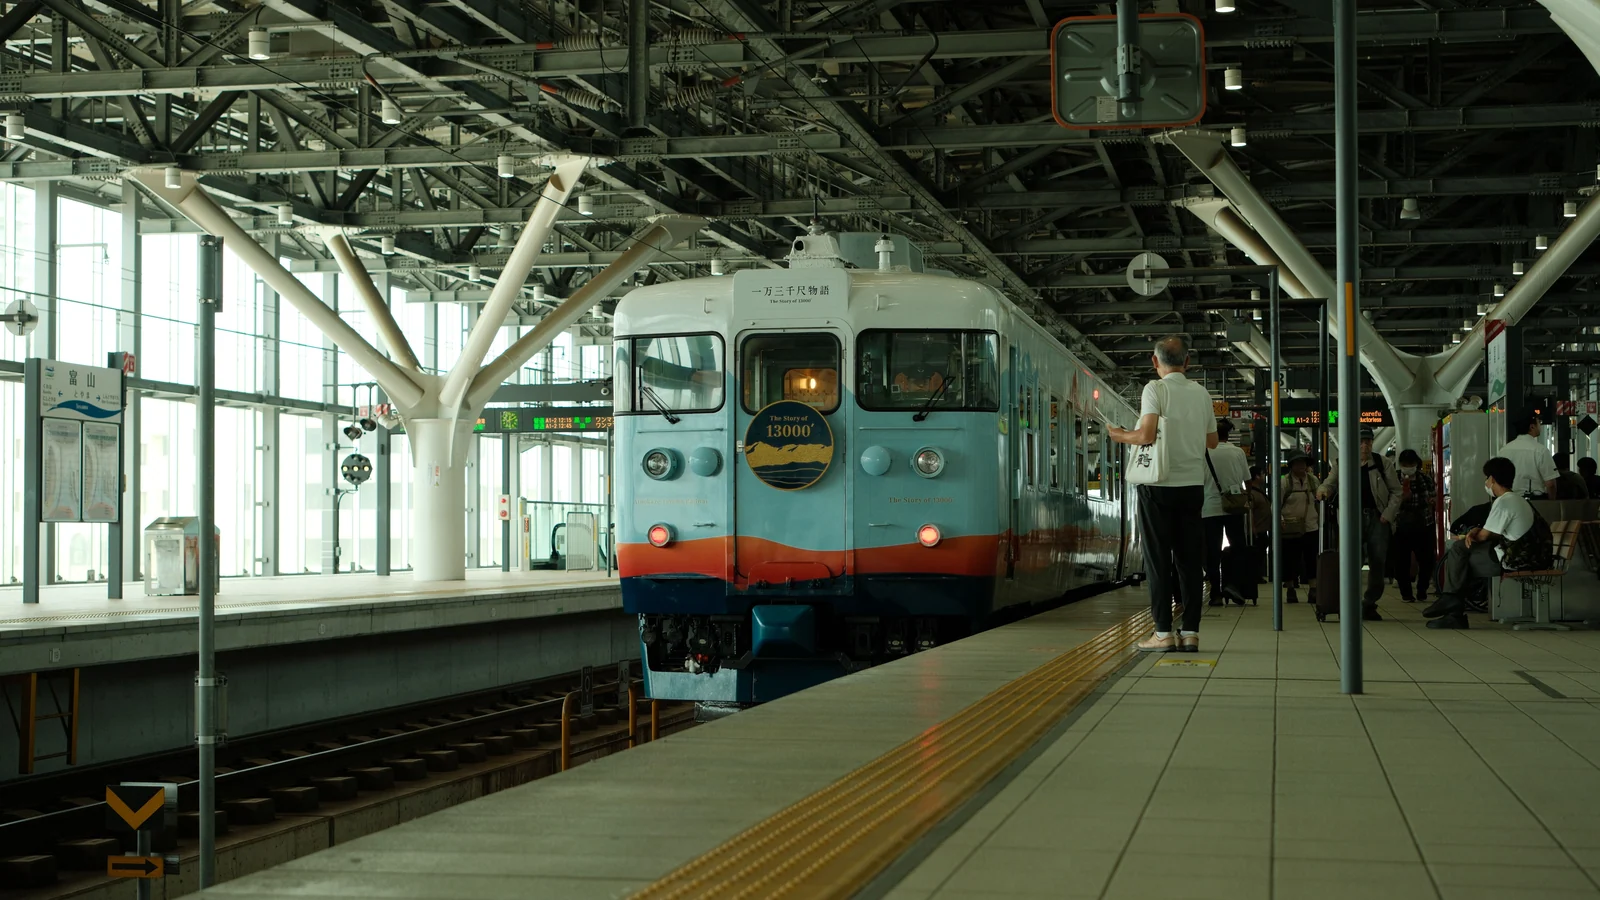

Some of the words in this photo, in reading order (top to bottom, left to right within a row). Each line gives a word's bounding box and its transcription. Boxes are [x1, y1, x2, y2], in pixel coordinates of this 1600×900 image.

[752, 285, 829, 296] 一万三千尺物語
[69, 369, 95, 388] 富山
[1538, 369, 1545, 383] 1
[74, 390, 90, 399] とやま
[1544, 398, 1548, 407] 1
